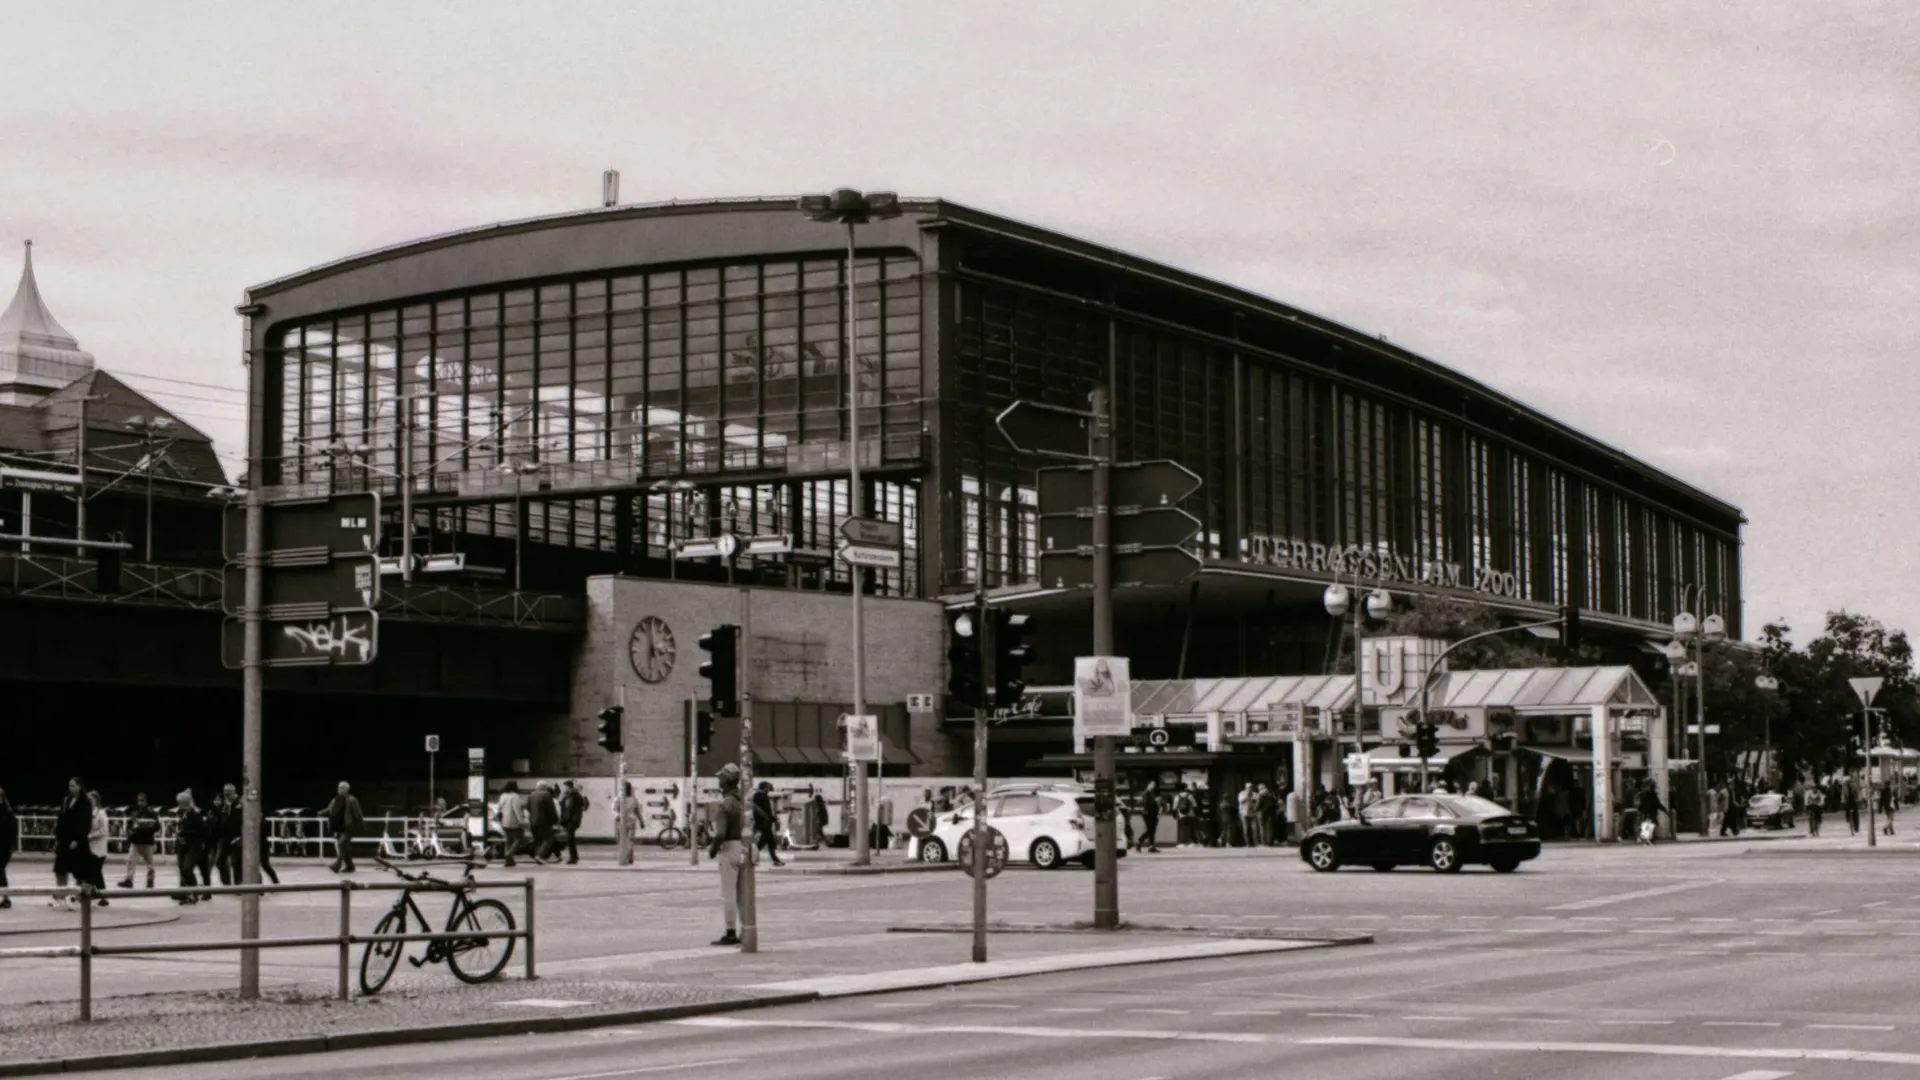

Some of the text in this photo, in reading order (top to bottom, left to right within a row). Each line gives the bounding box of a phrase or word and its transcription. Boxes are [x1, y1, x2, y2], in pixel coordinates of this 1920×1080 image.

[1252, 535, 1516, 597] TERRASSEN AM ZOO
[1369, 645, 1405, 697] U
